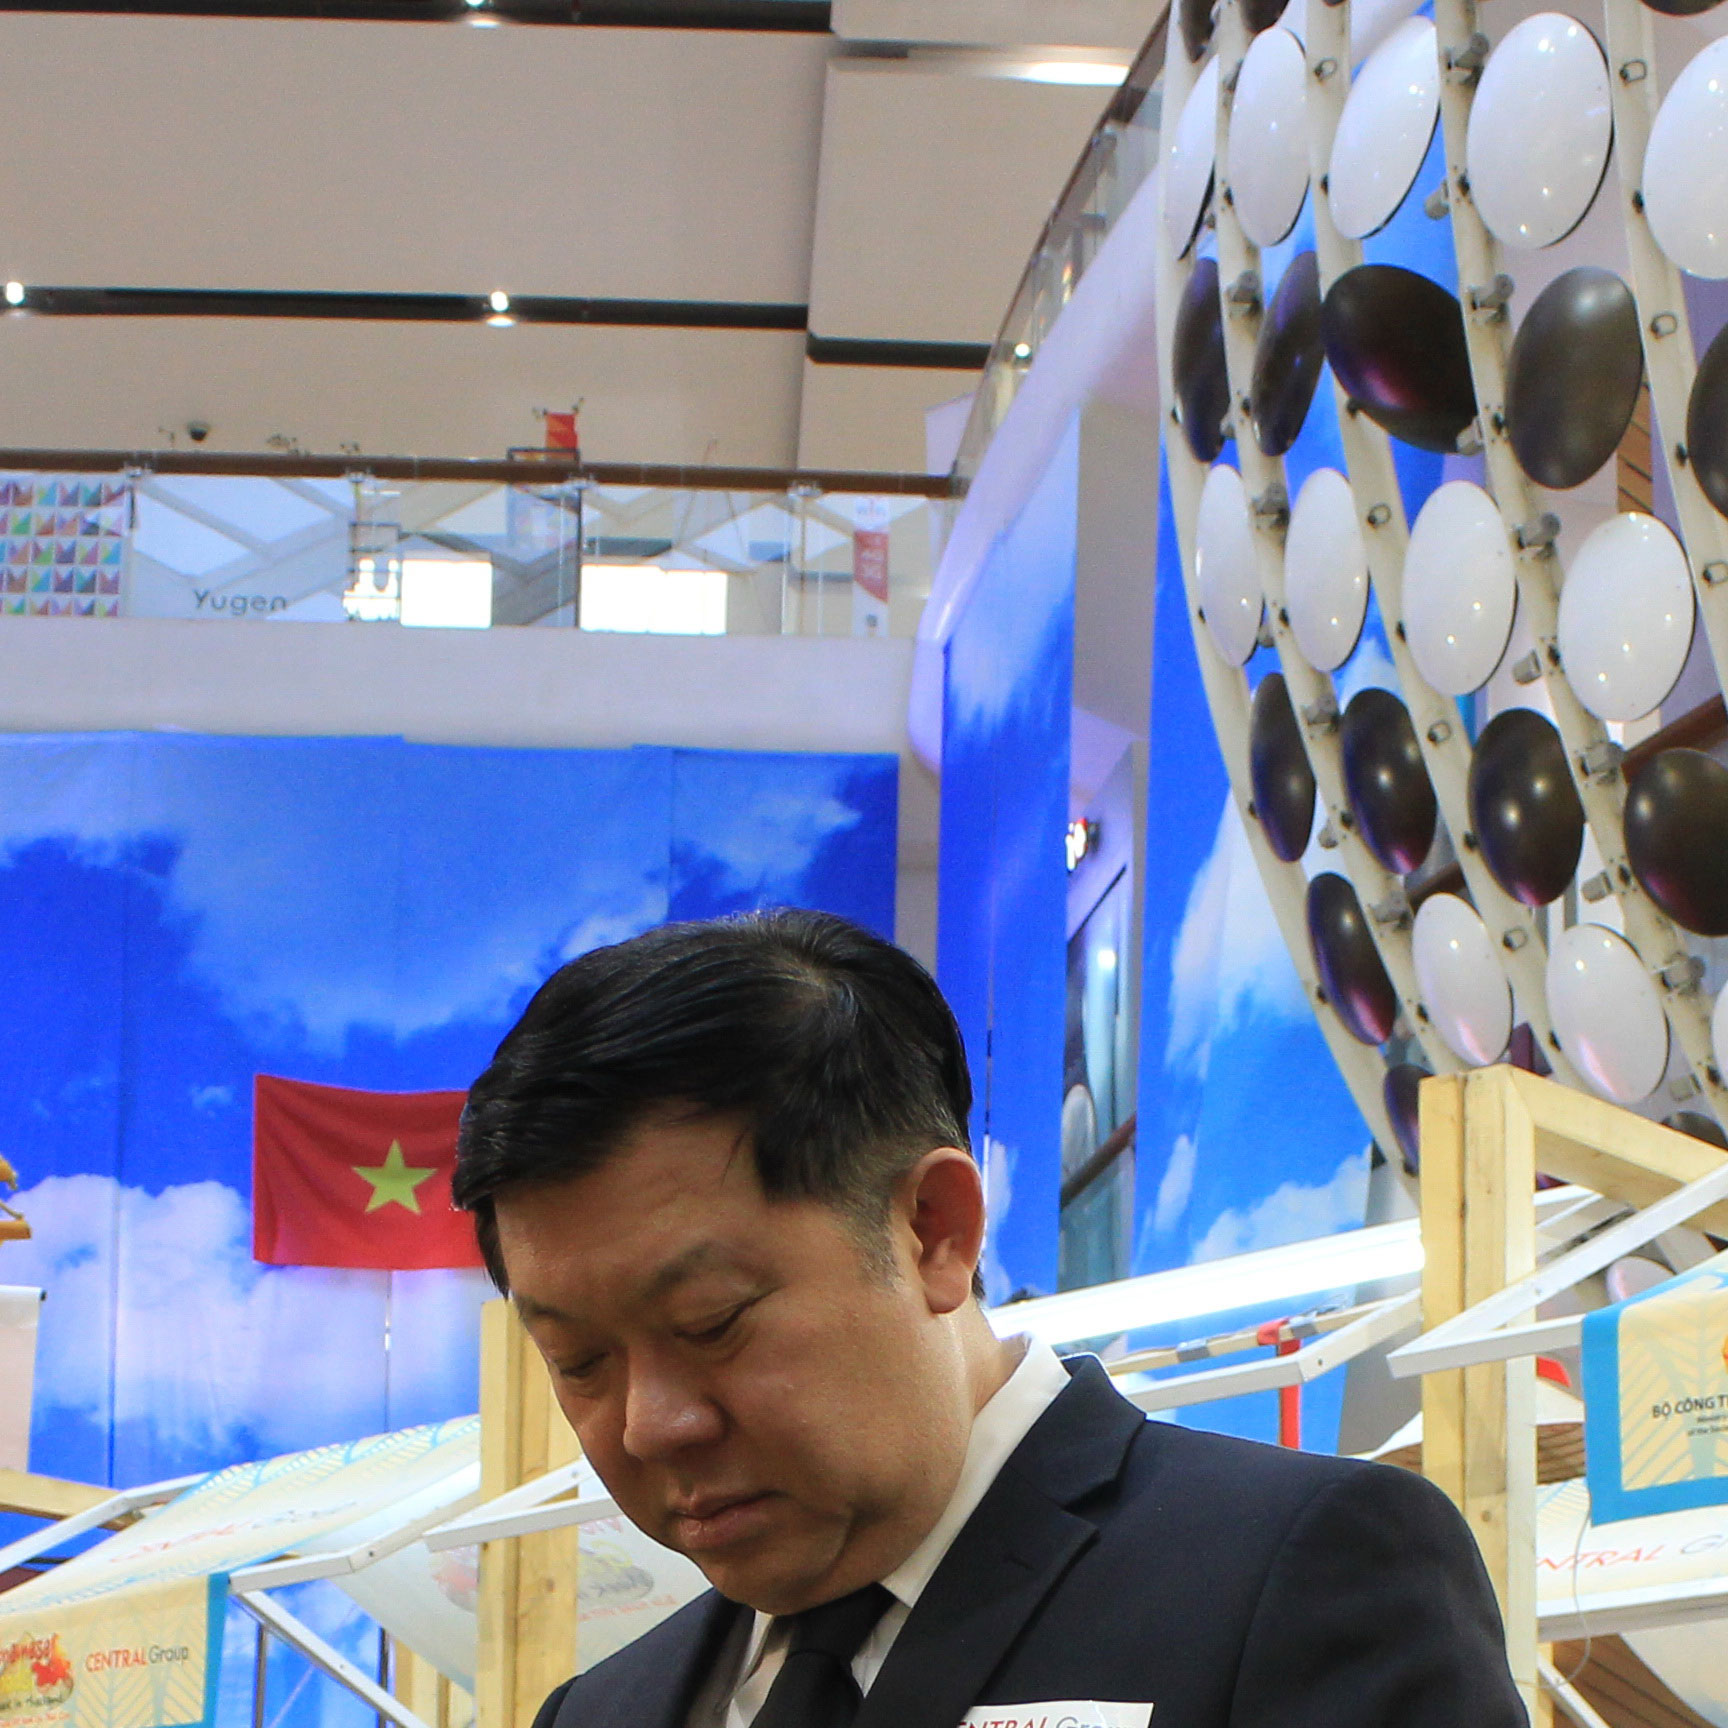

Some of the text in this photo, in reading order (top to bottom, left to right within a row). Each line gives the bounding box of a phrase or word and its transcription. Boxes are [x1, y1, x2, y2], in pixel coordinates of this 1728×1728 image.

[193, 589, 288, 616] Yugen
[1652, 1401, 1672, 1421] BỘ
[1674, 1396, 1715, 1415] CÔNG
[1538, 1543, 1666, 1572] NTRAL
[85, 1644, 189, 1673] CENTRAL Group
